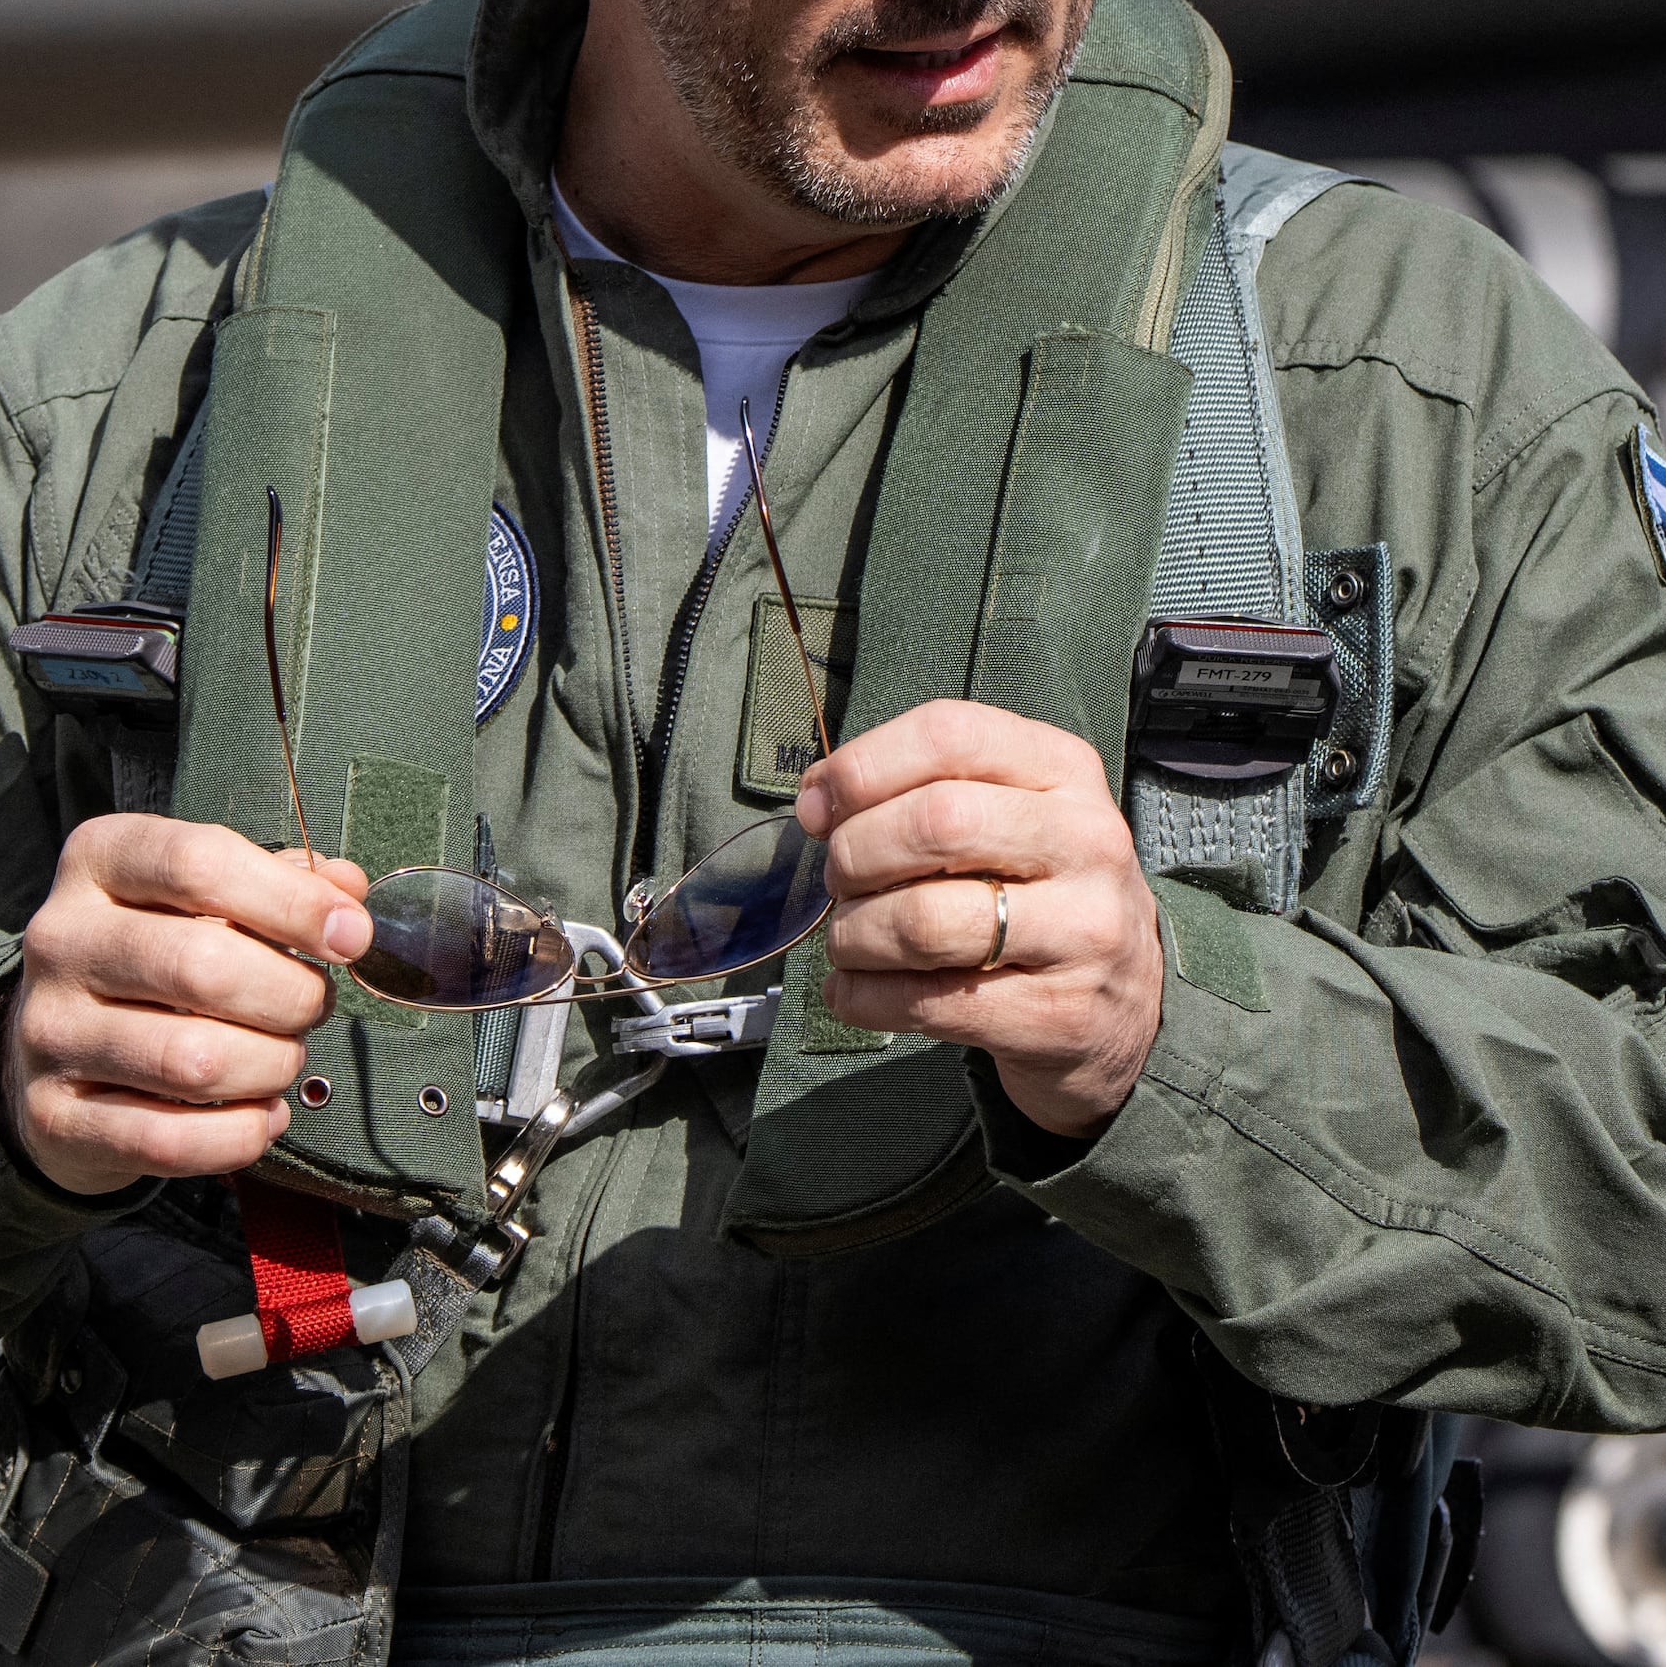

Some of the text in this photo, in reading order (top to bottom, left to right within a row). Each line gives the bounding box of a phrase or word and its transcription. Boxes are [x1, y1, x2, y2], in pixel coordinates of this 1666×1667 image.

[488, 523, 521, 605] ENSA
[476, 646, 514, 704] INA
[1196, 668, 1272, 682] FMT-279
